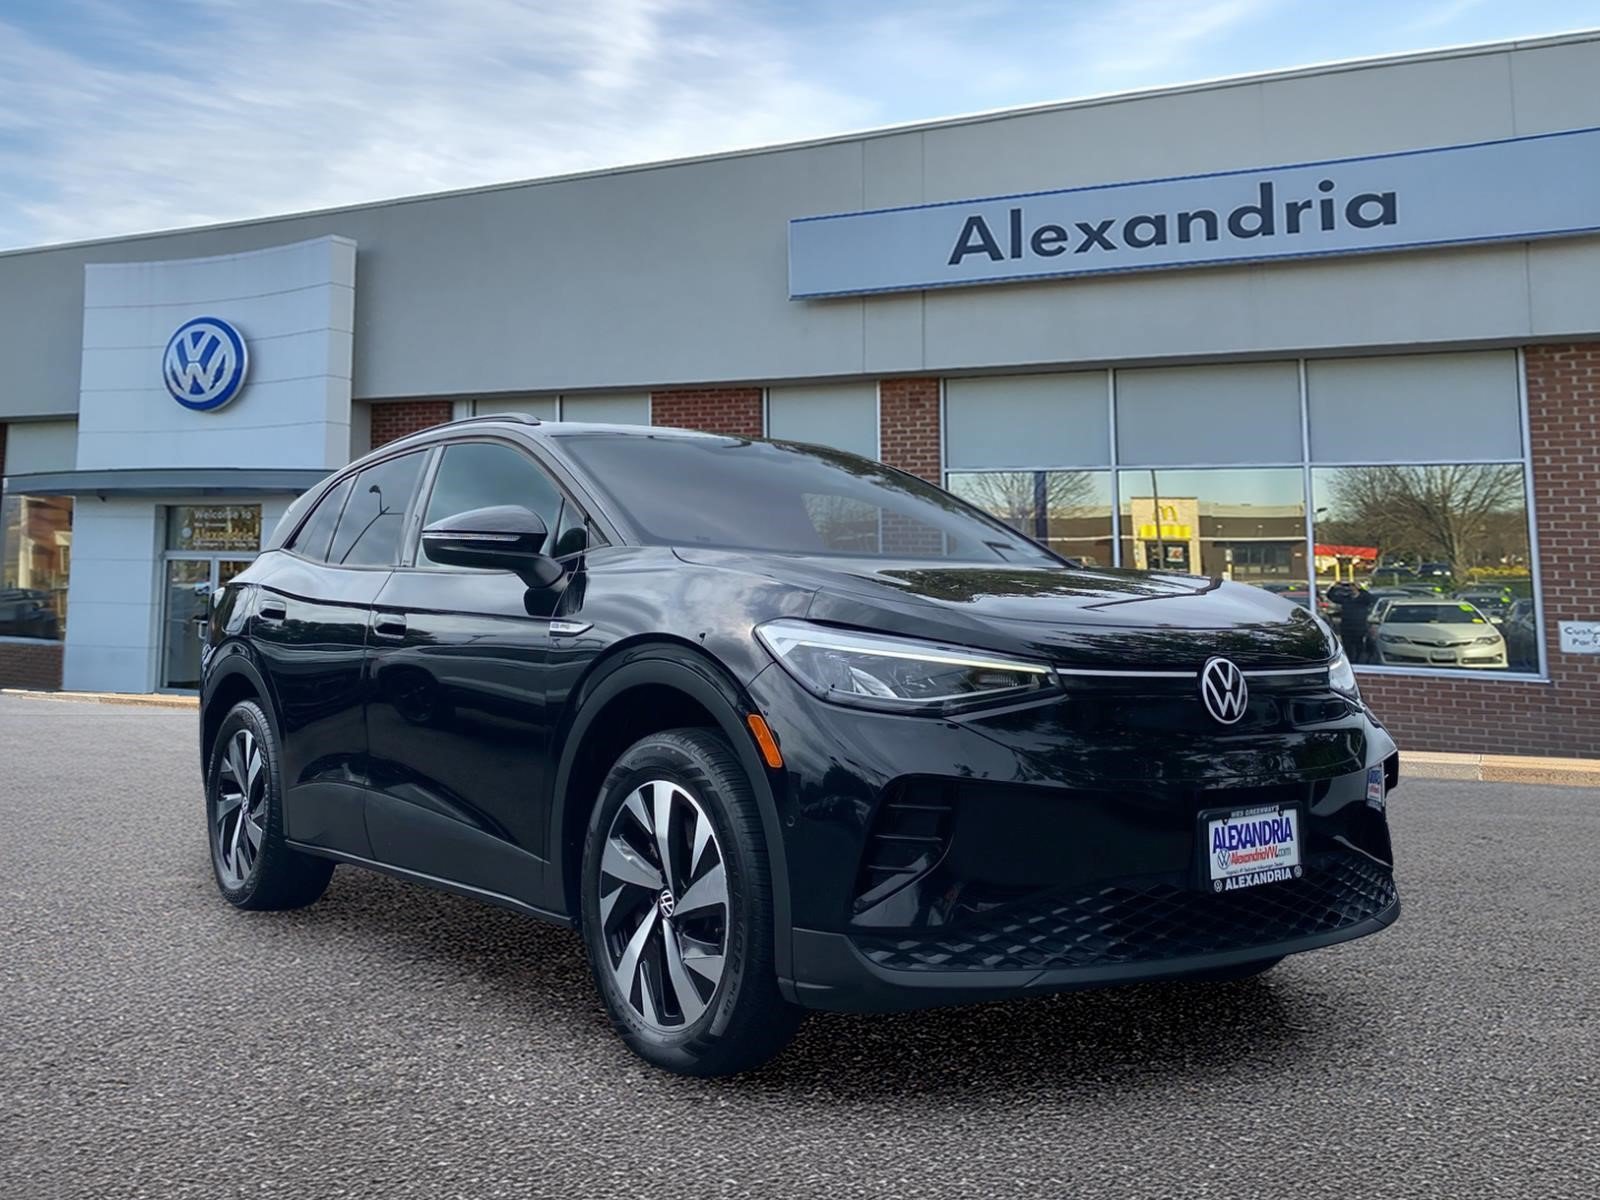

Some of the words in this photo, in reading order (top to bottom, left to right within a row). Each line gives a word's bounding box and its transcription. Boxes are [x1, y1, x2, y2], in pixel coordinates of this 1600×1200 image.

[948, 179, 1398, 265] Alexandria
[166, 322, 238, 403] VW
[1203, 659, 1247, 722] VW
[1213, 817, 1294, 854] ALEXANDRIA
[1225, 867, 1292, 890] ALEXANDRIA
